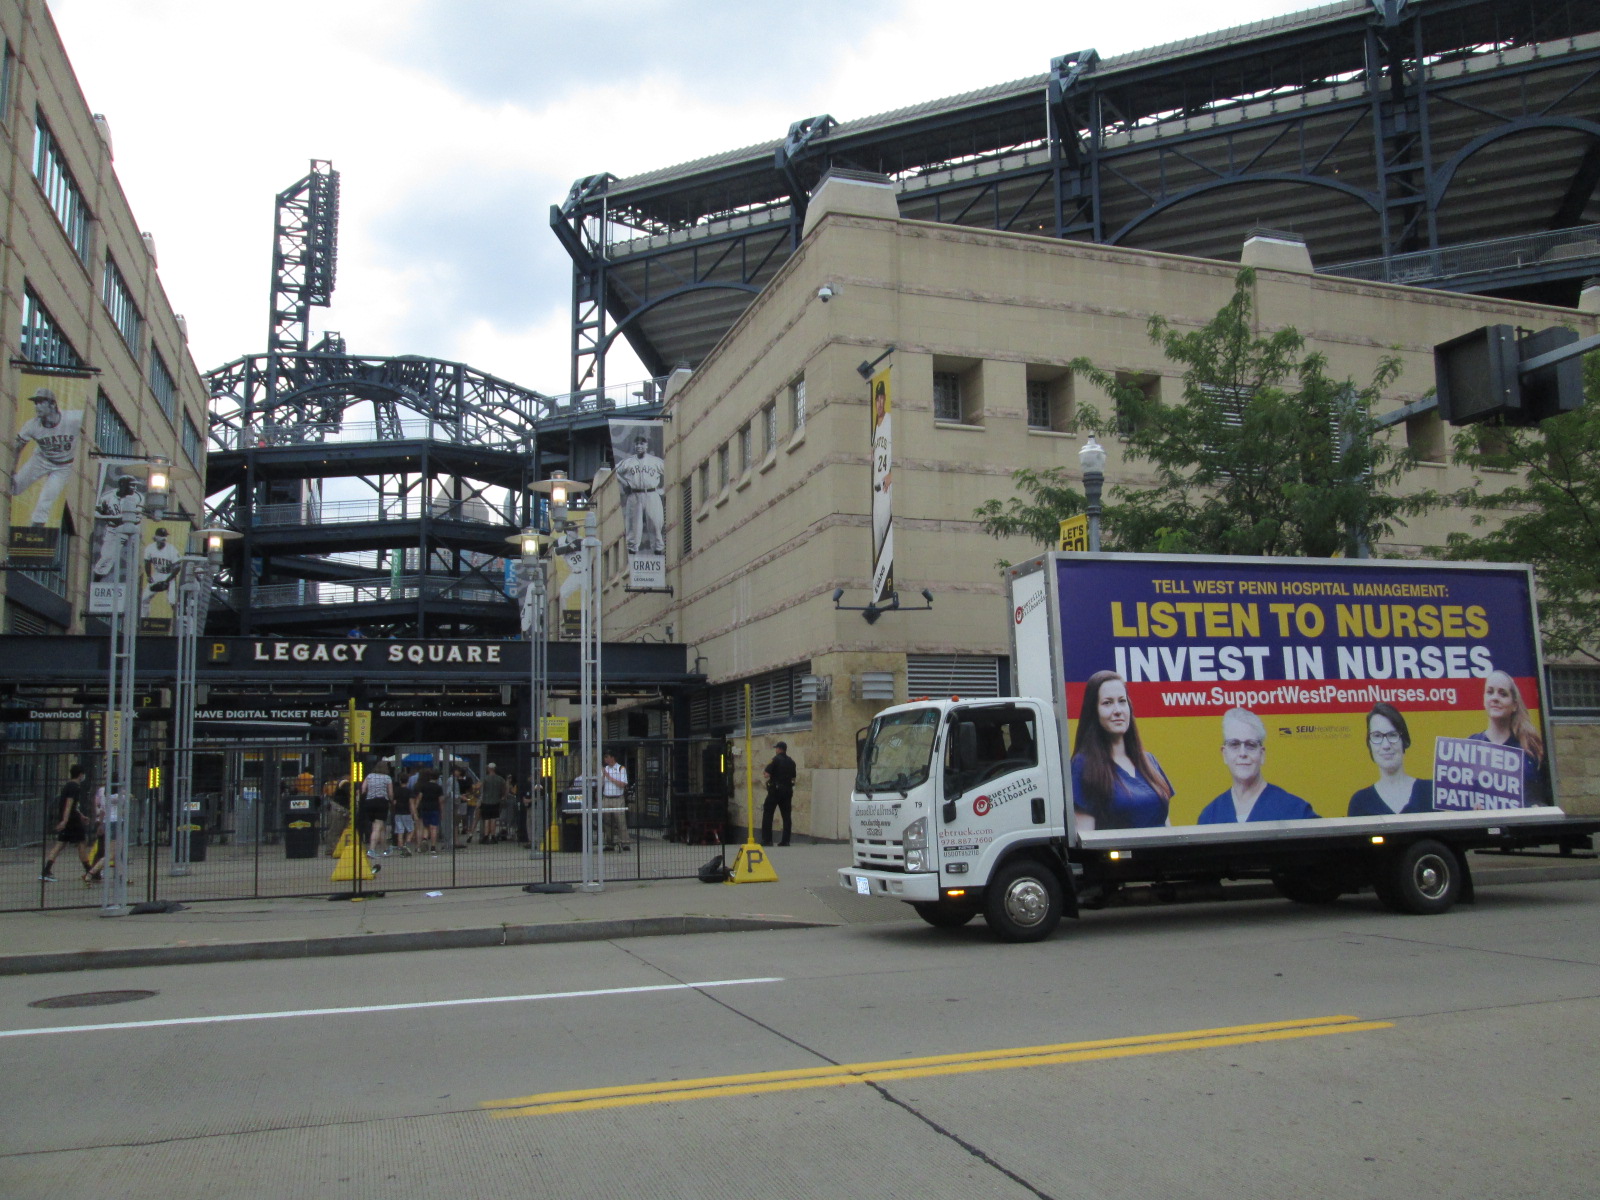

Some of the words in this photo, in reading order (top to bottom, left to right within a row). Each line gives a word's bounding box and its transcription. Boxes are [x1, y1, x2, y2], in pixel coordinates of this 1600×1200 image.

[631, 465, 657, 477] GRAYS
[877, 454, 888, 472] 24
[1062, 524, 1084, 541] LET'S
[633, 560, 661, 571] GRAYS
[874, 565, 886, 594] EVANS
[94, 587, 123, 597] GRAS
[1152, 580, 1190, 593] TELL
[1193, 580, 1234, 594] WEST
[1239, 581, 1277, 595] PENN
[1282, 582, 1349, 596] HOSPITAL
[1353, 583, 1449, 597] MANAGEMENT:
[1111, 601, 1260, 637] LISTEN
[1269, 603, 1325, 638] TO
[1336, 604, 1489, 638] NURSES
[212, 643, 225, 659] P
[254, 642, 368, 661] LEGACY
[387, 645, 501, 664] SQUARE
[1114, 646, 1270, 682] INVEST
[1283, 646, 1324, 680] IN
[1337, 645, 1494, 680] NURSES
[1161, 685, 1457, 708] www.SupportWestPennNurses.org
[30, 710, 82, 719] Download
[194, 710, 223, 719] HAVE
[226, 710, 268, 718] DIGITAL
[271, 710, 308, 718] TICKET
[310, 710, 339, 718] READ
[1438, 740, 1520, 772] UNITED
[1436, 765, 1474, 786] FOR
[1478, 770, 1520, 795] OUR
[987, 777, 1032, 802] guerrilla
[914, 801, 924, 809] T9
[1436, 787, 1520, 810] PATIENTS
[939, 827, 993, 838] gbtruck.com
[941, 836, 993, 846] 978.887.7600
[746, 849, 763, 873] P
